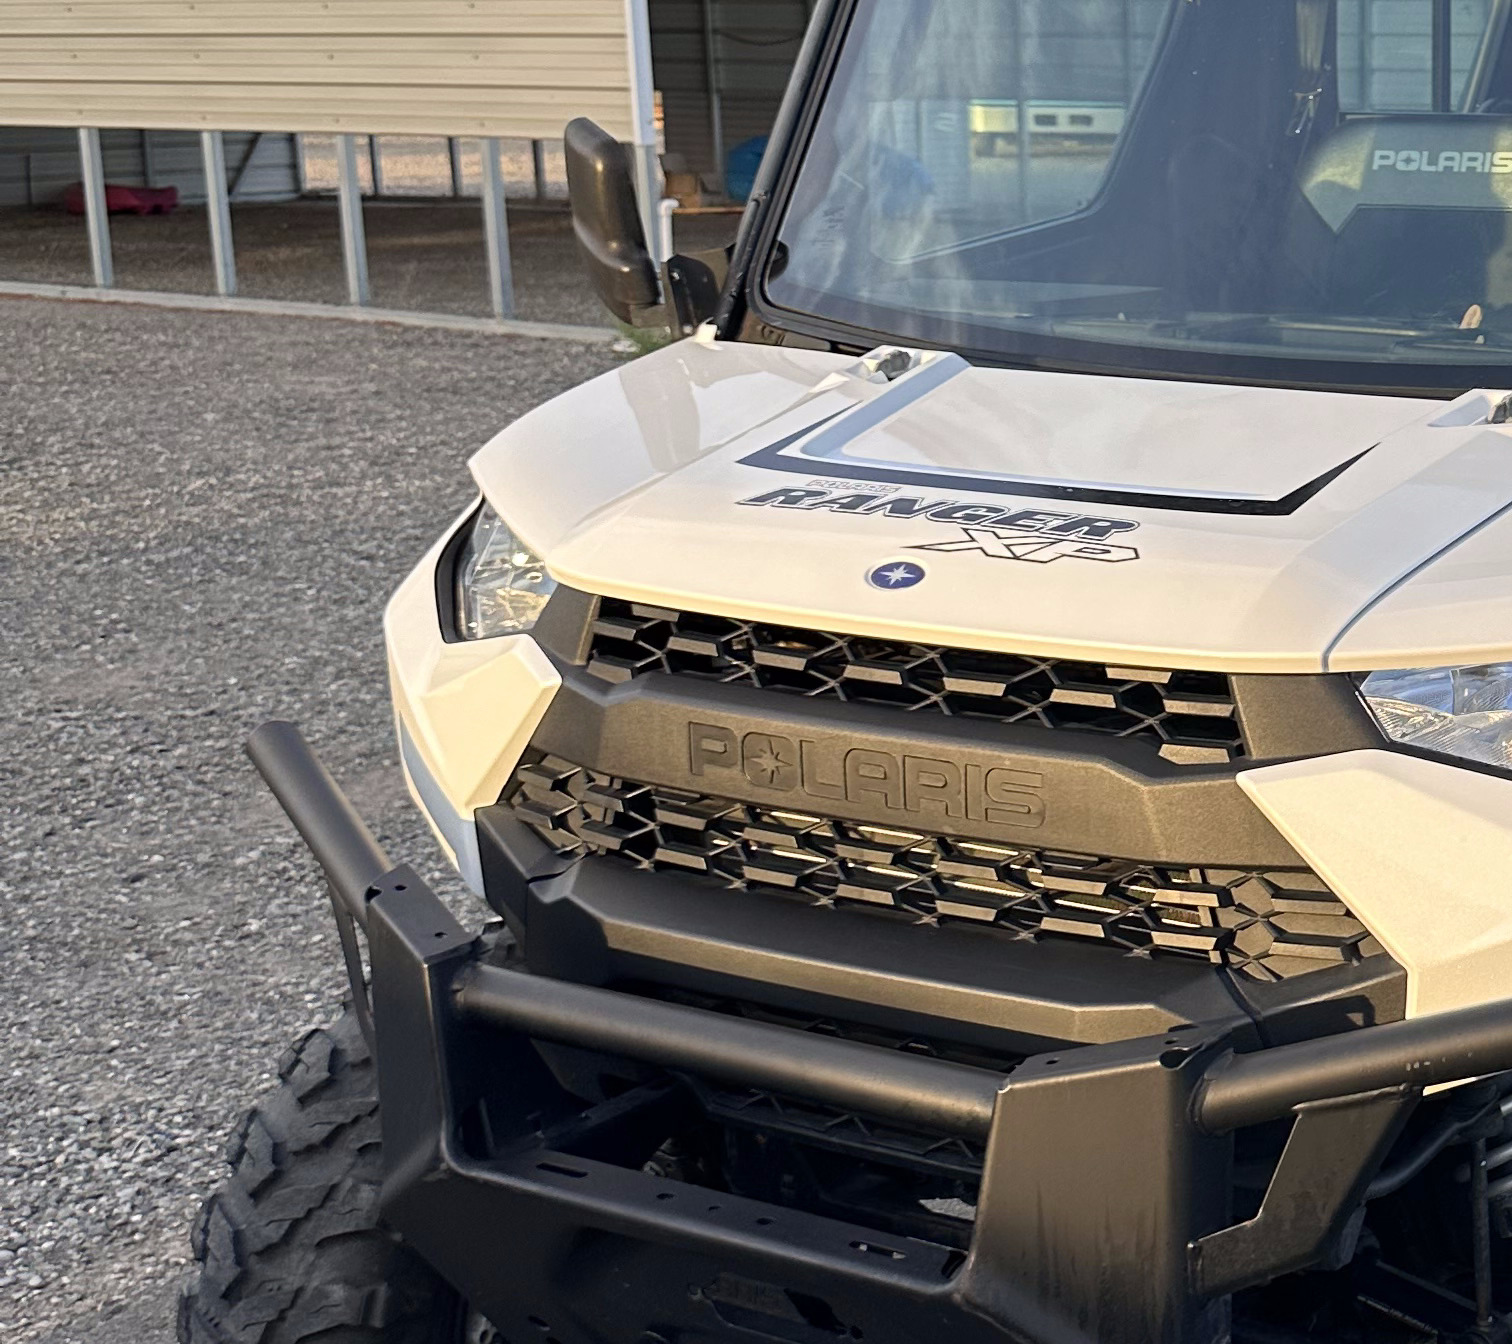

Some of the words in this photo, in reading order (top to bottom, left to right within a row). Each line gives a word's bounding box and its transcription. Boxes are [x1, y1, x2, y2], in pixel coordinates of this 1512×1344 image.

[806, 479, 902, 494] POLARIS
[736, 486, 1140, 542] RANGER
[902, 527, 1141, 563] XP
[688, 720, 1047, 829] POLARIS
